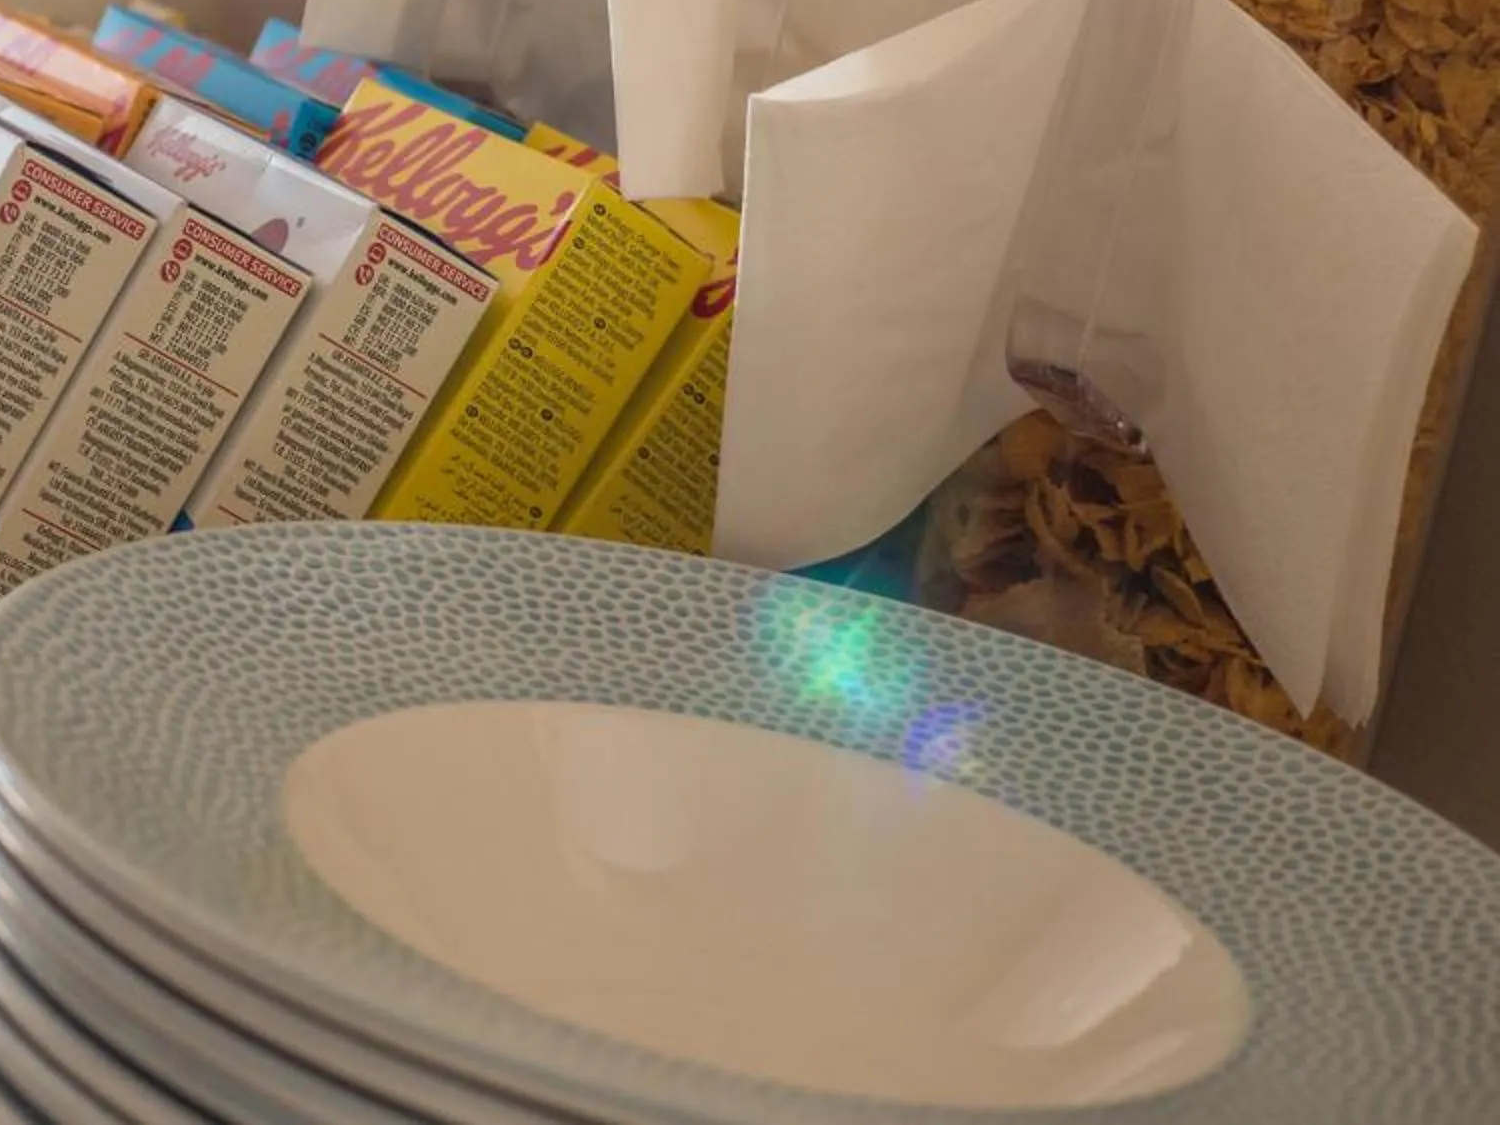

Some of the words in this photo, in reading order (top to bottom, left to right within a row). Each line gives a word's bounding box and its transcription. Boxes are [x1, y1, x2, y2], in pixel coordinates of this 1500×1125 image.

[24, 163, 92, 208] CONSUMER
[92, 201, 143, 236] SERVICE
[313, 88, 578, 273] Kellogg's
[185, 222, 250, 264] CONSUMER
[250, 259, 300, 293] SERVICE
[379, 226, 440, 270] CONSUMER
[440, 264, 488, 298] SERVICE
